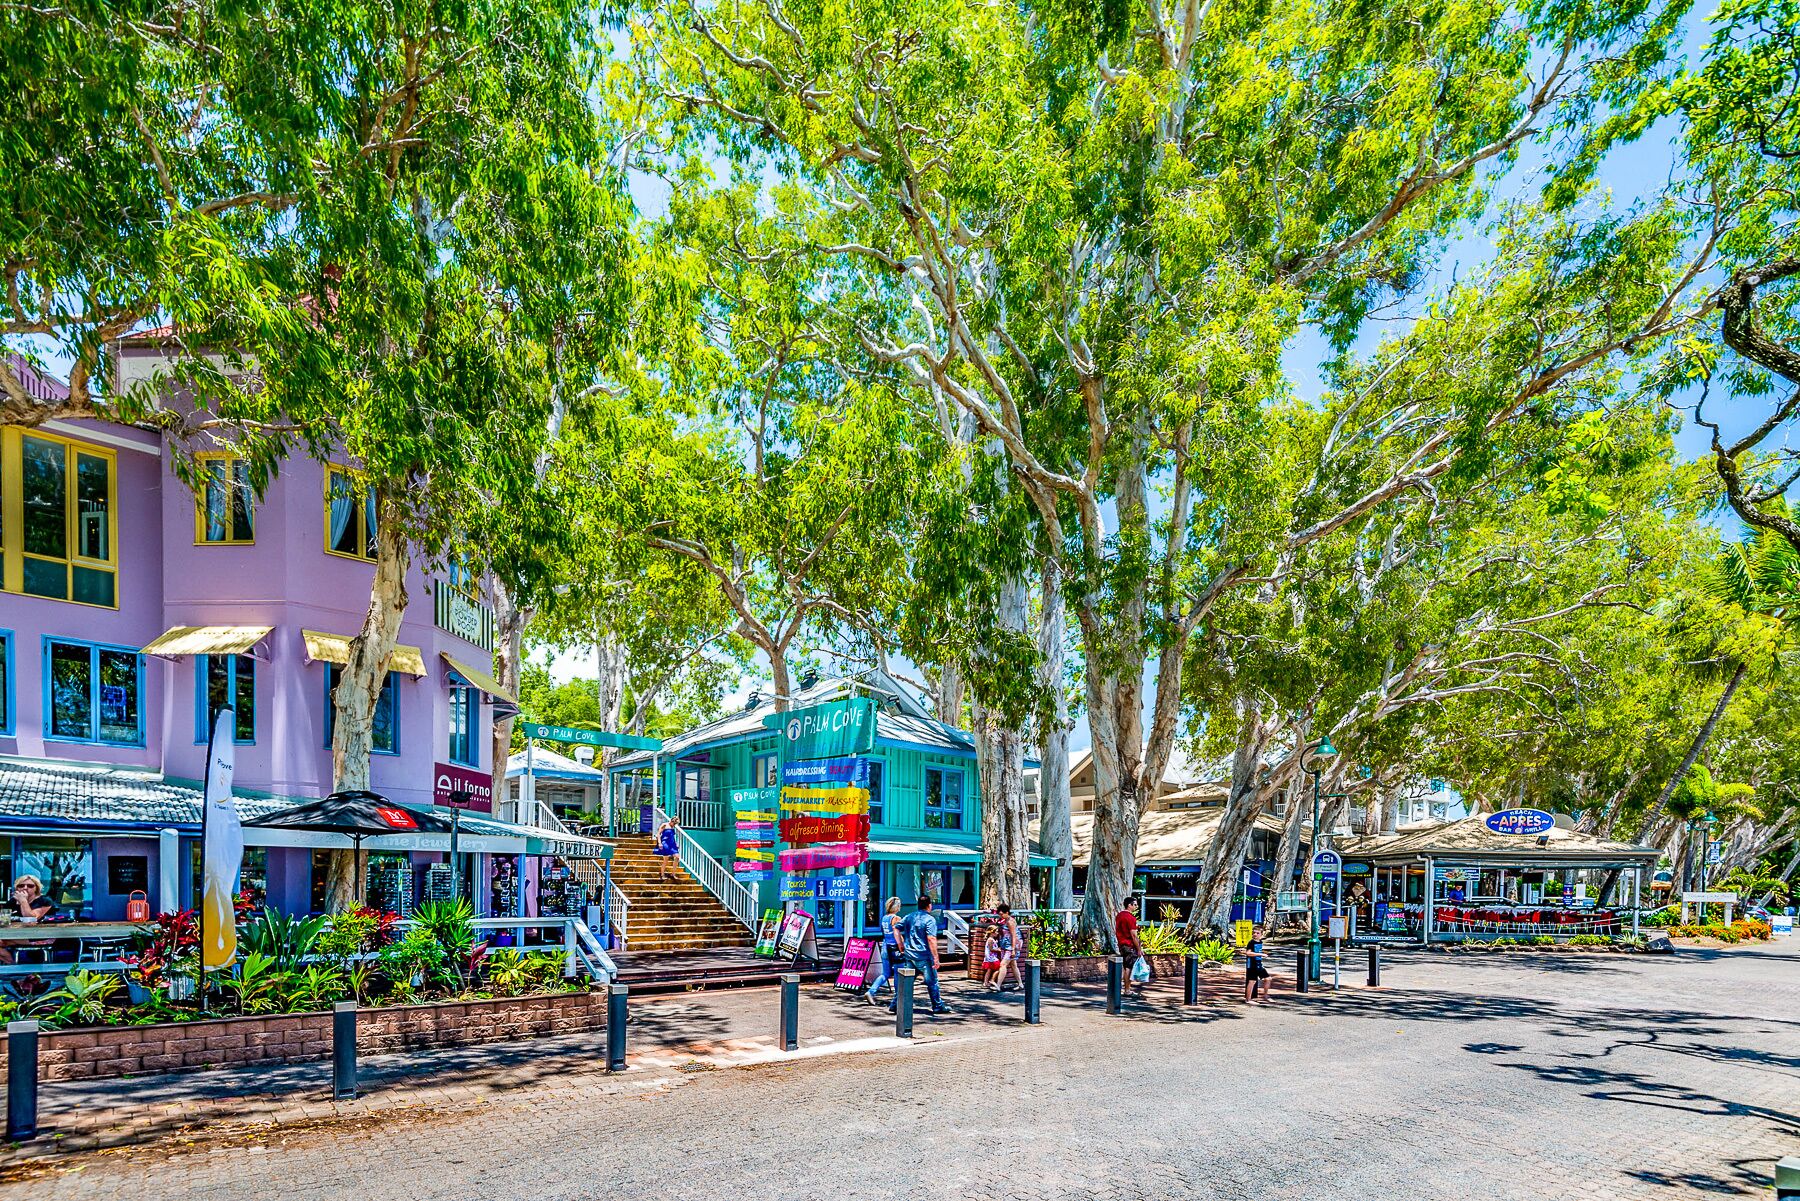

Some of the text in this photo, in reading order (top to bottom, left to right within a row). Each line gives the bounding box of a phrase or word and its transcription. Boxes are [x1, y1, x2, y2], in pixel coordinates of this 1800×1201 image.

[457, 618, 476, 634] ROOM
[803, 706, 863, 738] PALM COVE
[553, 728, 595, 741] PALM COVE
[785, 765, 855, 777] HAIRDRESSING BEAUTY
[454, 778, 490, 798] il forno
[743, 791, 759, 801] PALM
[782, 791, 859, 810] SUPERMARKET MASSAGE
[1499, 815, 1542, 827] APRES
[789, 822, 819, 840] alfresco
[378, 836, 488, 850] ine Jewelery
[552, 840, 602, 857] JEWELLER
[787, 880, 807, 889] Tourist
[832, 879, 851, 888] POST
[828, 888, 855, 897] OFFICE
[845, 957, 868, 971] OPEN
[842, 968, 865, 978] UPSTAIRS
